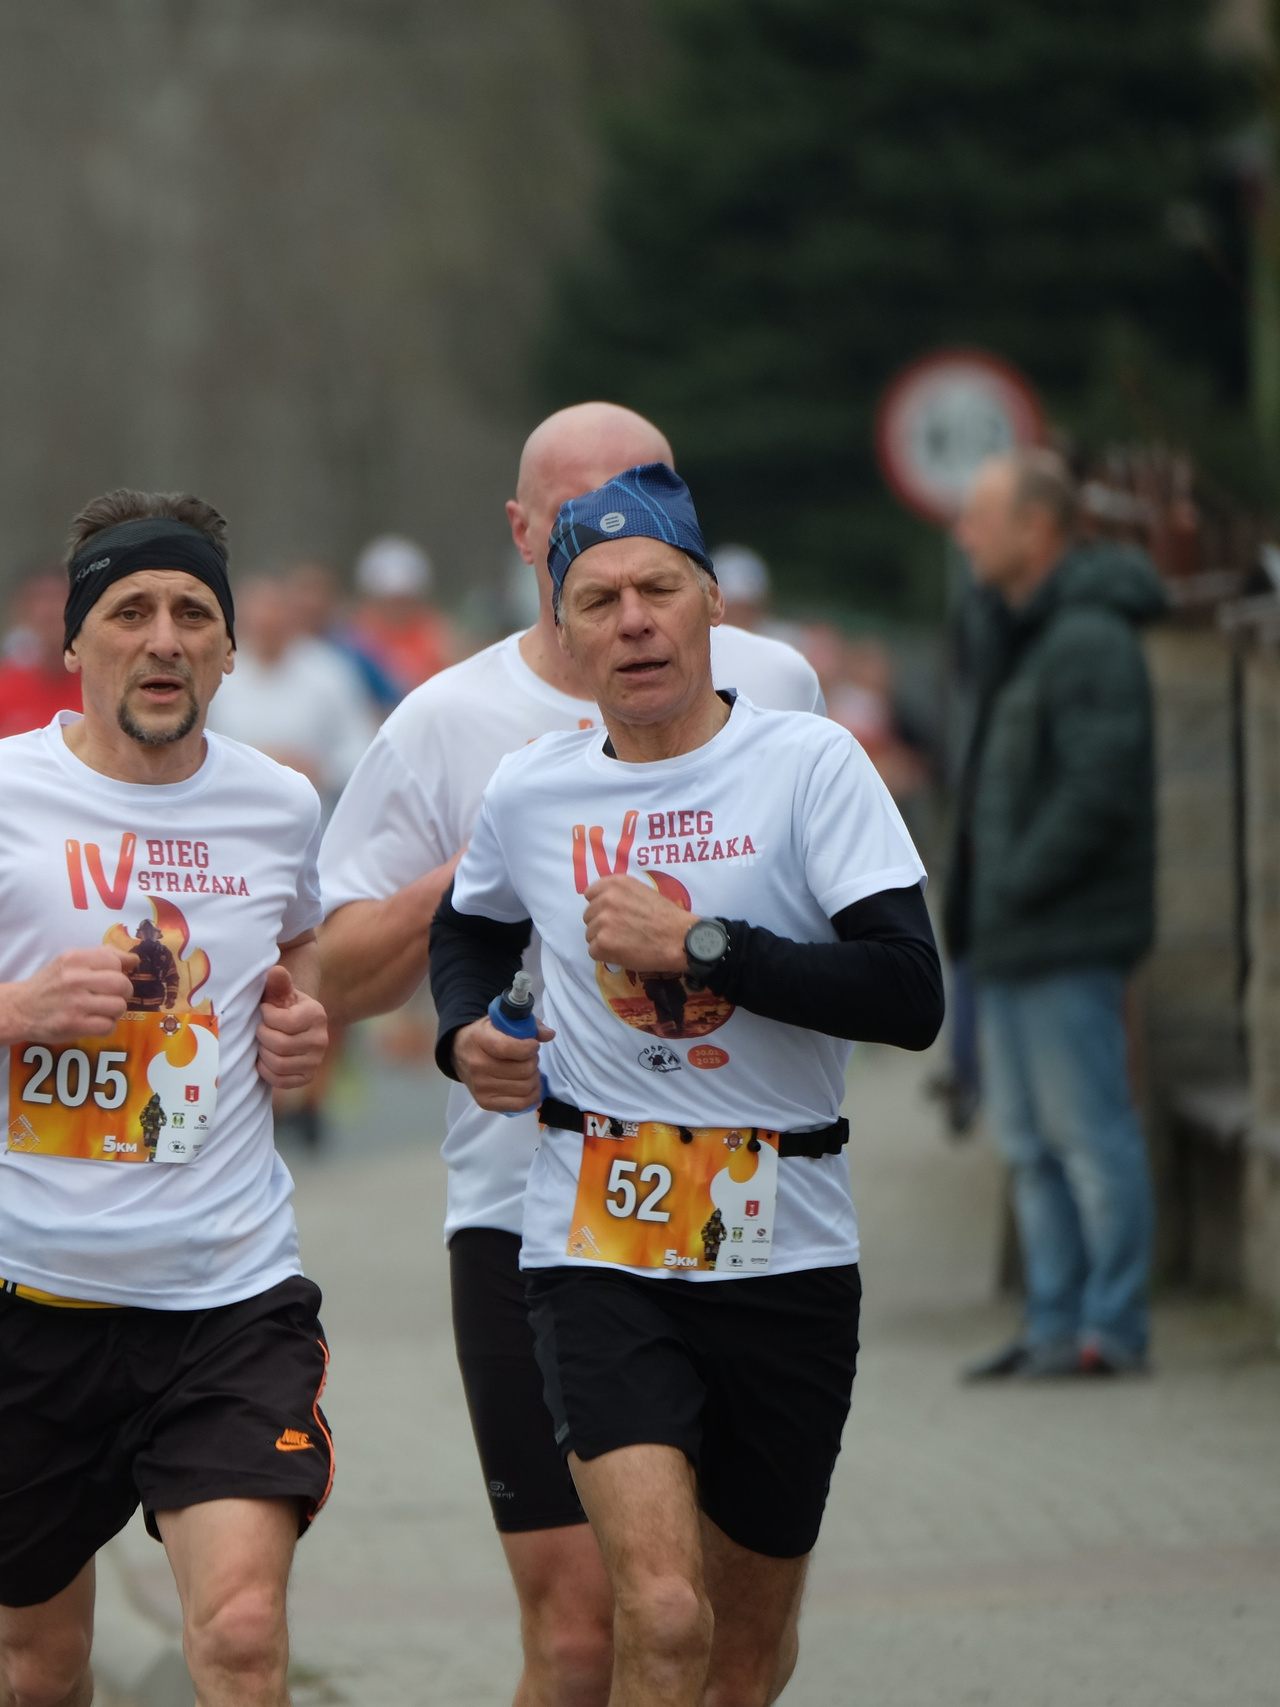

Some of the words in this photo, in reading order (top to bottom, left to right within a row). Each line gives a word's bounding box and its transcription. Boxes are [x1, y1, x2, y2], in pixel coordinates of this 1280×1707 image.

[65, 832, 137, 910] IV
[146, 840, 209, 868] BIEG
[572, 810, 639, 894] IV
[647, 810, 713, 840] BIEG
[636, 835, 756, 866] STRAŻAKA
[137, 870, 251, 896] STRAŻAKA
[22, 1045, 128, 1110] 205
[102, 1134, 138, 1154] 5KM
[606, 1159, 672, 1223] 52
[663, 1248, 698, 1267] 5KM
